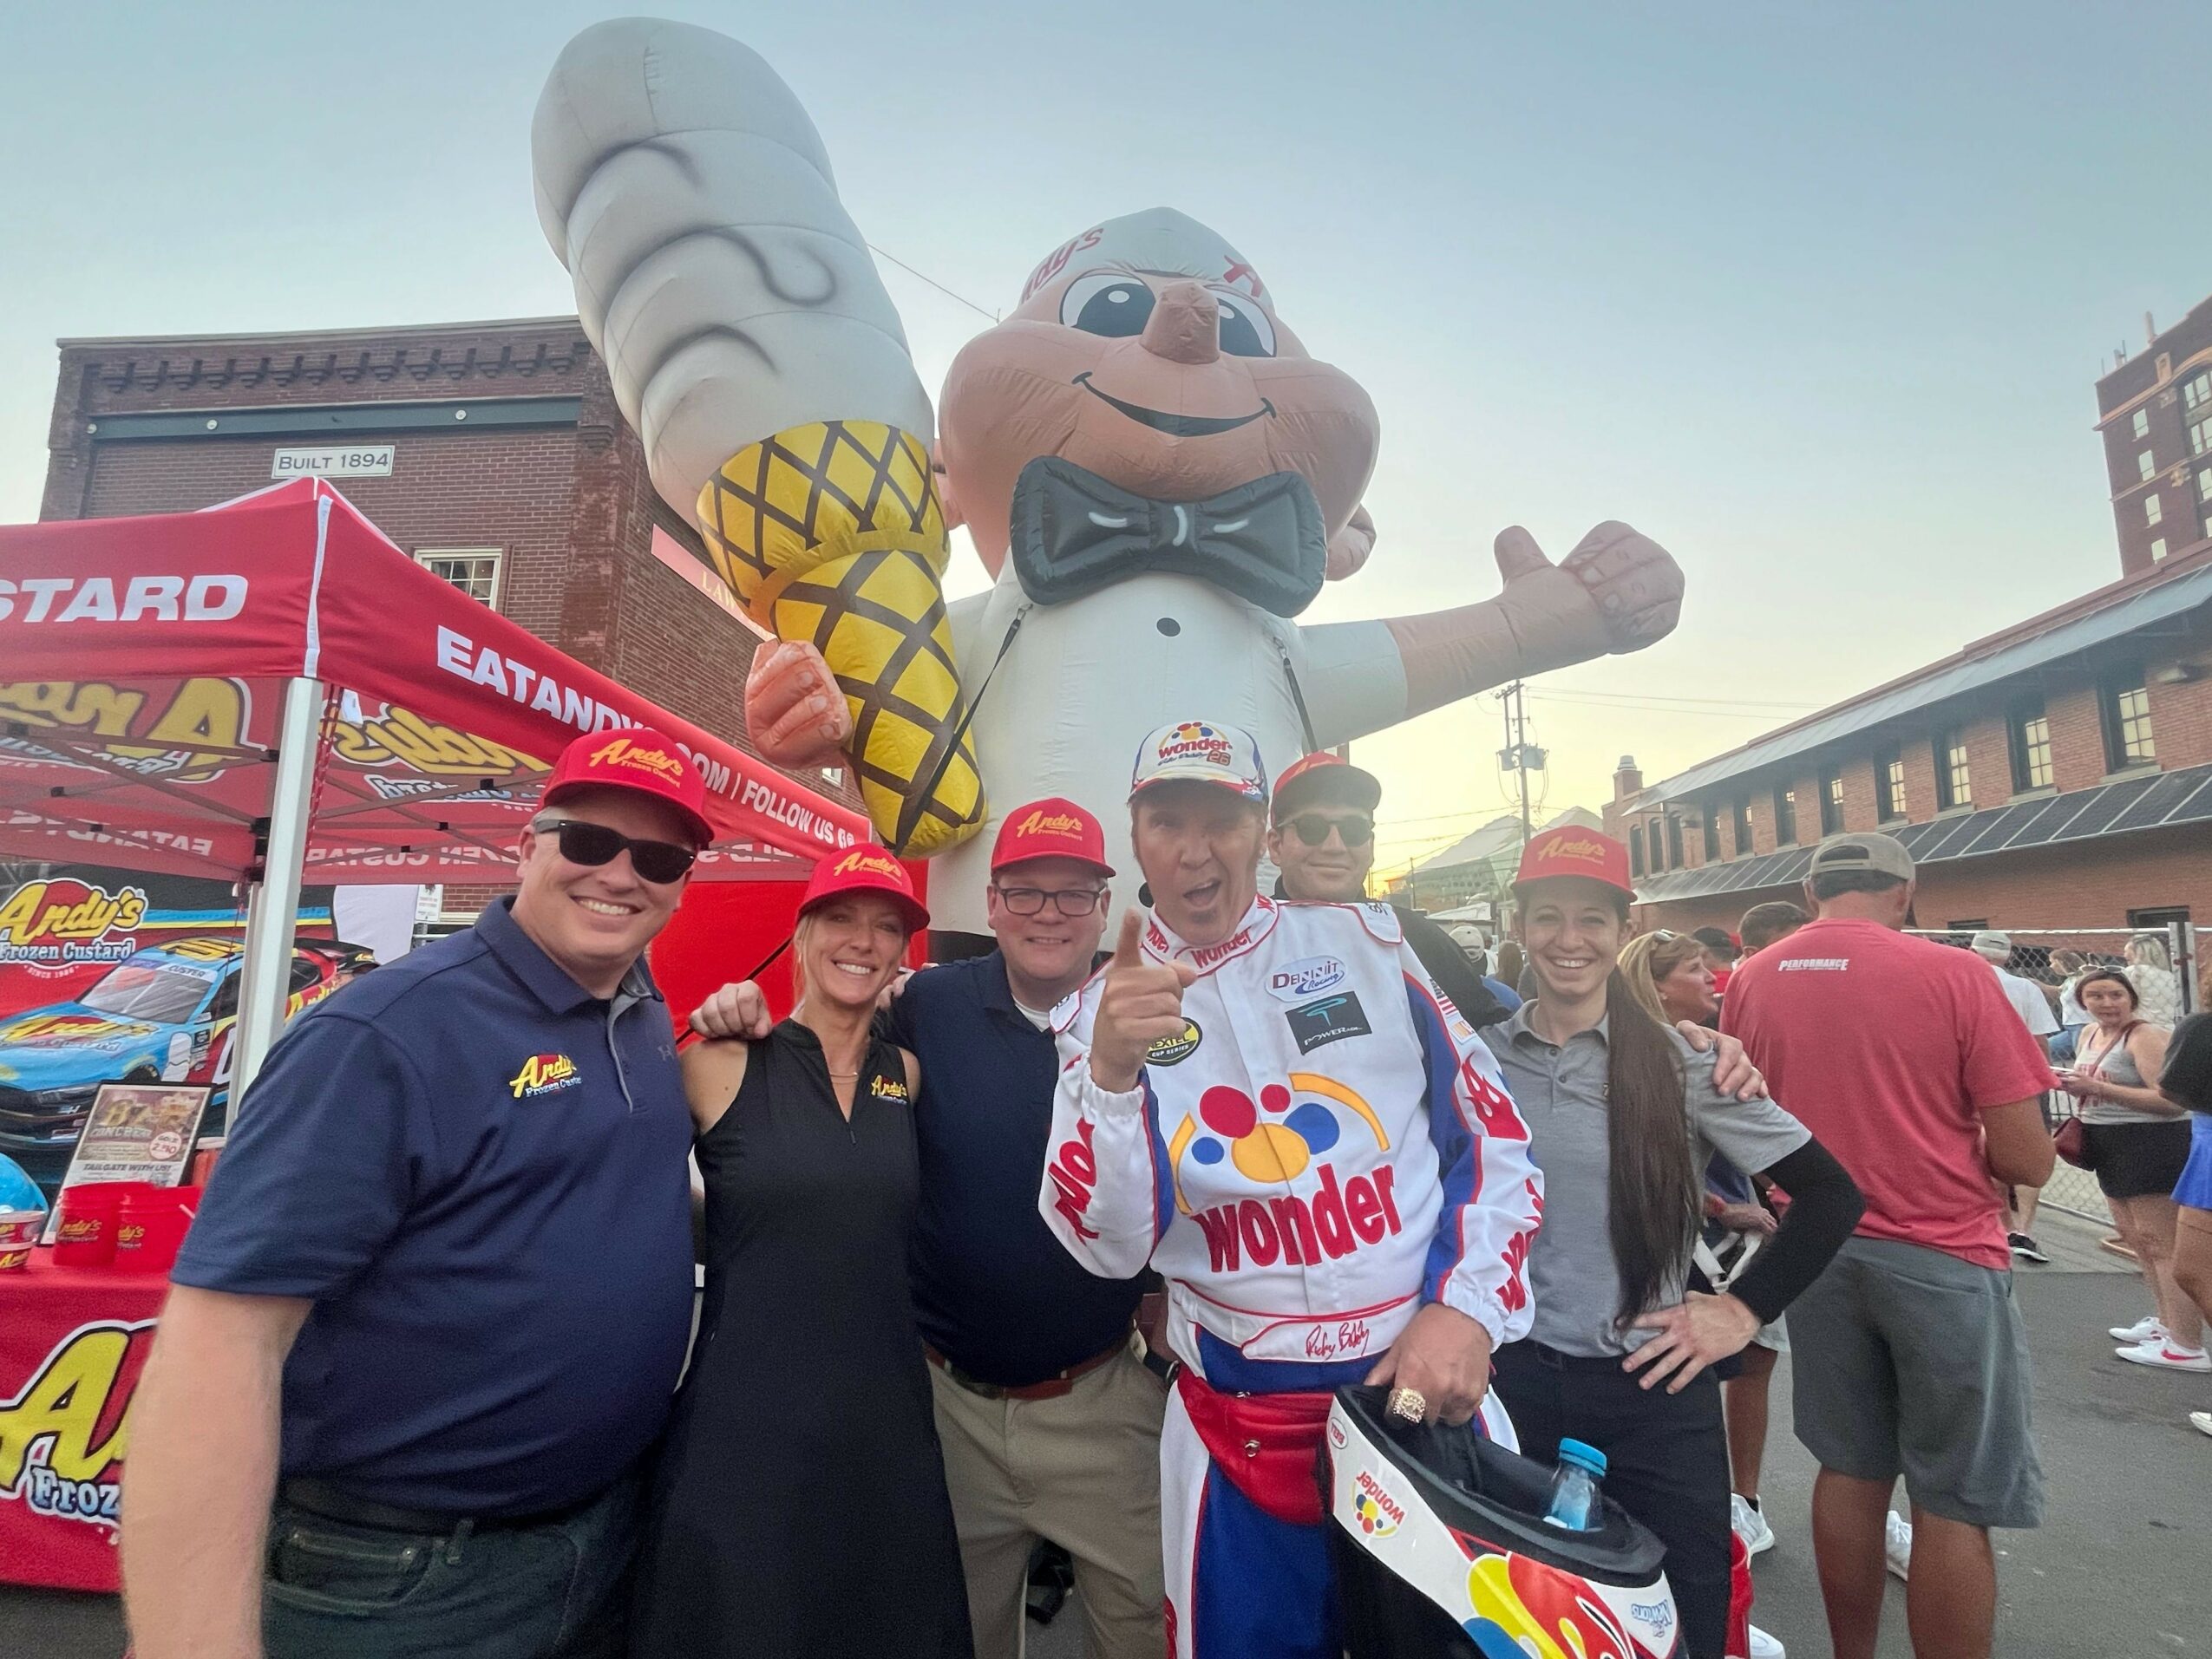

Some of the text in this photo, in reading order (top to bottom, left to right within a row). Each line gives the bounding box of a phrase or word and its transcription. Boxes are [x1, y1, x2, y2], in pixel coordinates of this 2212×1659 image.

[278, 453, 389, 470] BUILT 1894
[589, 739, 684, 777] Andy's
[1158, 738, 1230, 759] wonder
[741, 779, 815, 833] FOLLOW
[814, 816, 835, 845] US
[1017, 811, 1083, 839] Andy's
[834, 852, 902, 878] Andy's
[0, 883, 145, 945] Andy's
[62, 940, 131, 961] Custard
[168, 964, 206, 977] CUSTER
[1778, 958, 1849, 971] PERFORMANCE
[1166, 1044, 1189, 1055] SERIES
[525, 1081, 560, 1098] Frozen
[1190, 1163, 1402, 1273] wonder
[31, 1466, 120, 1516] Froz
[1355, 1471, 1405, 1525] wonder
